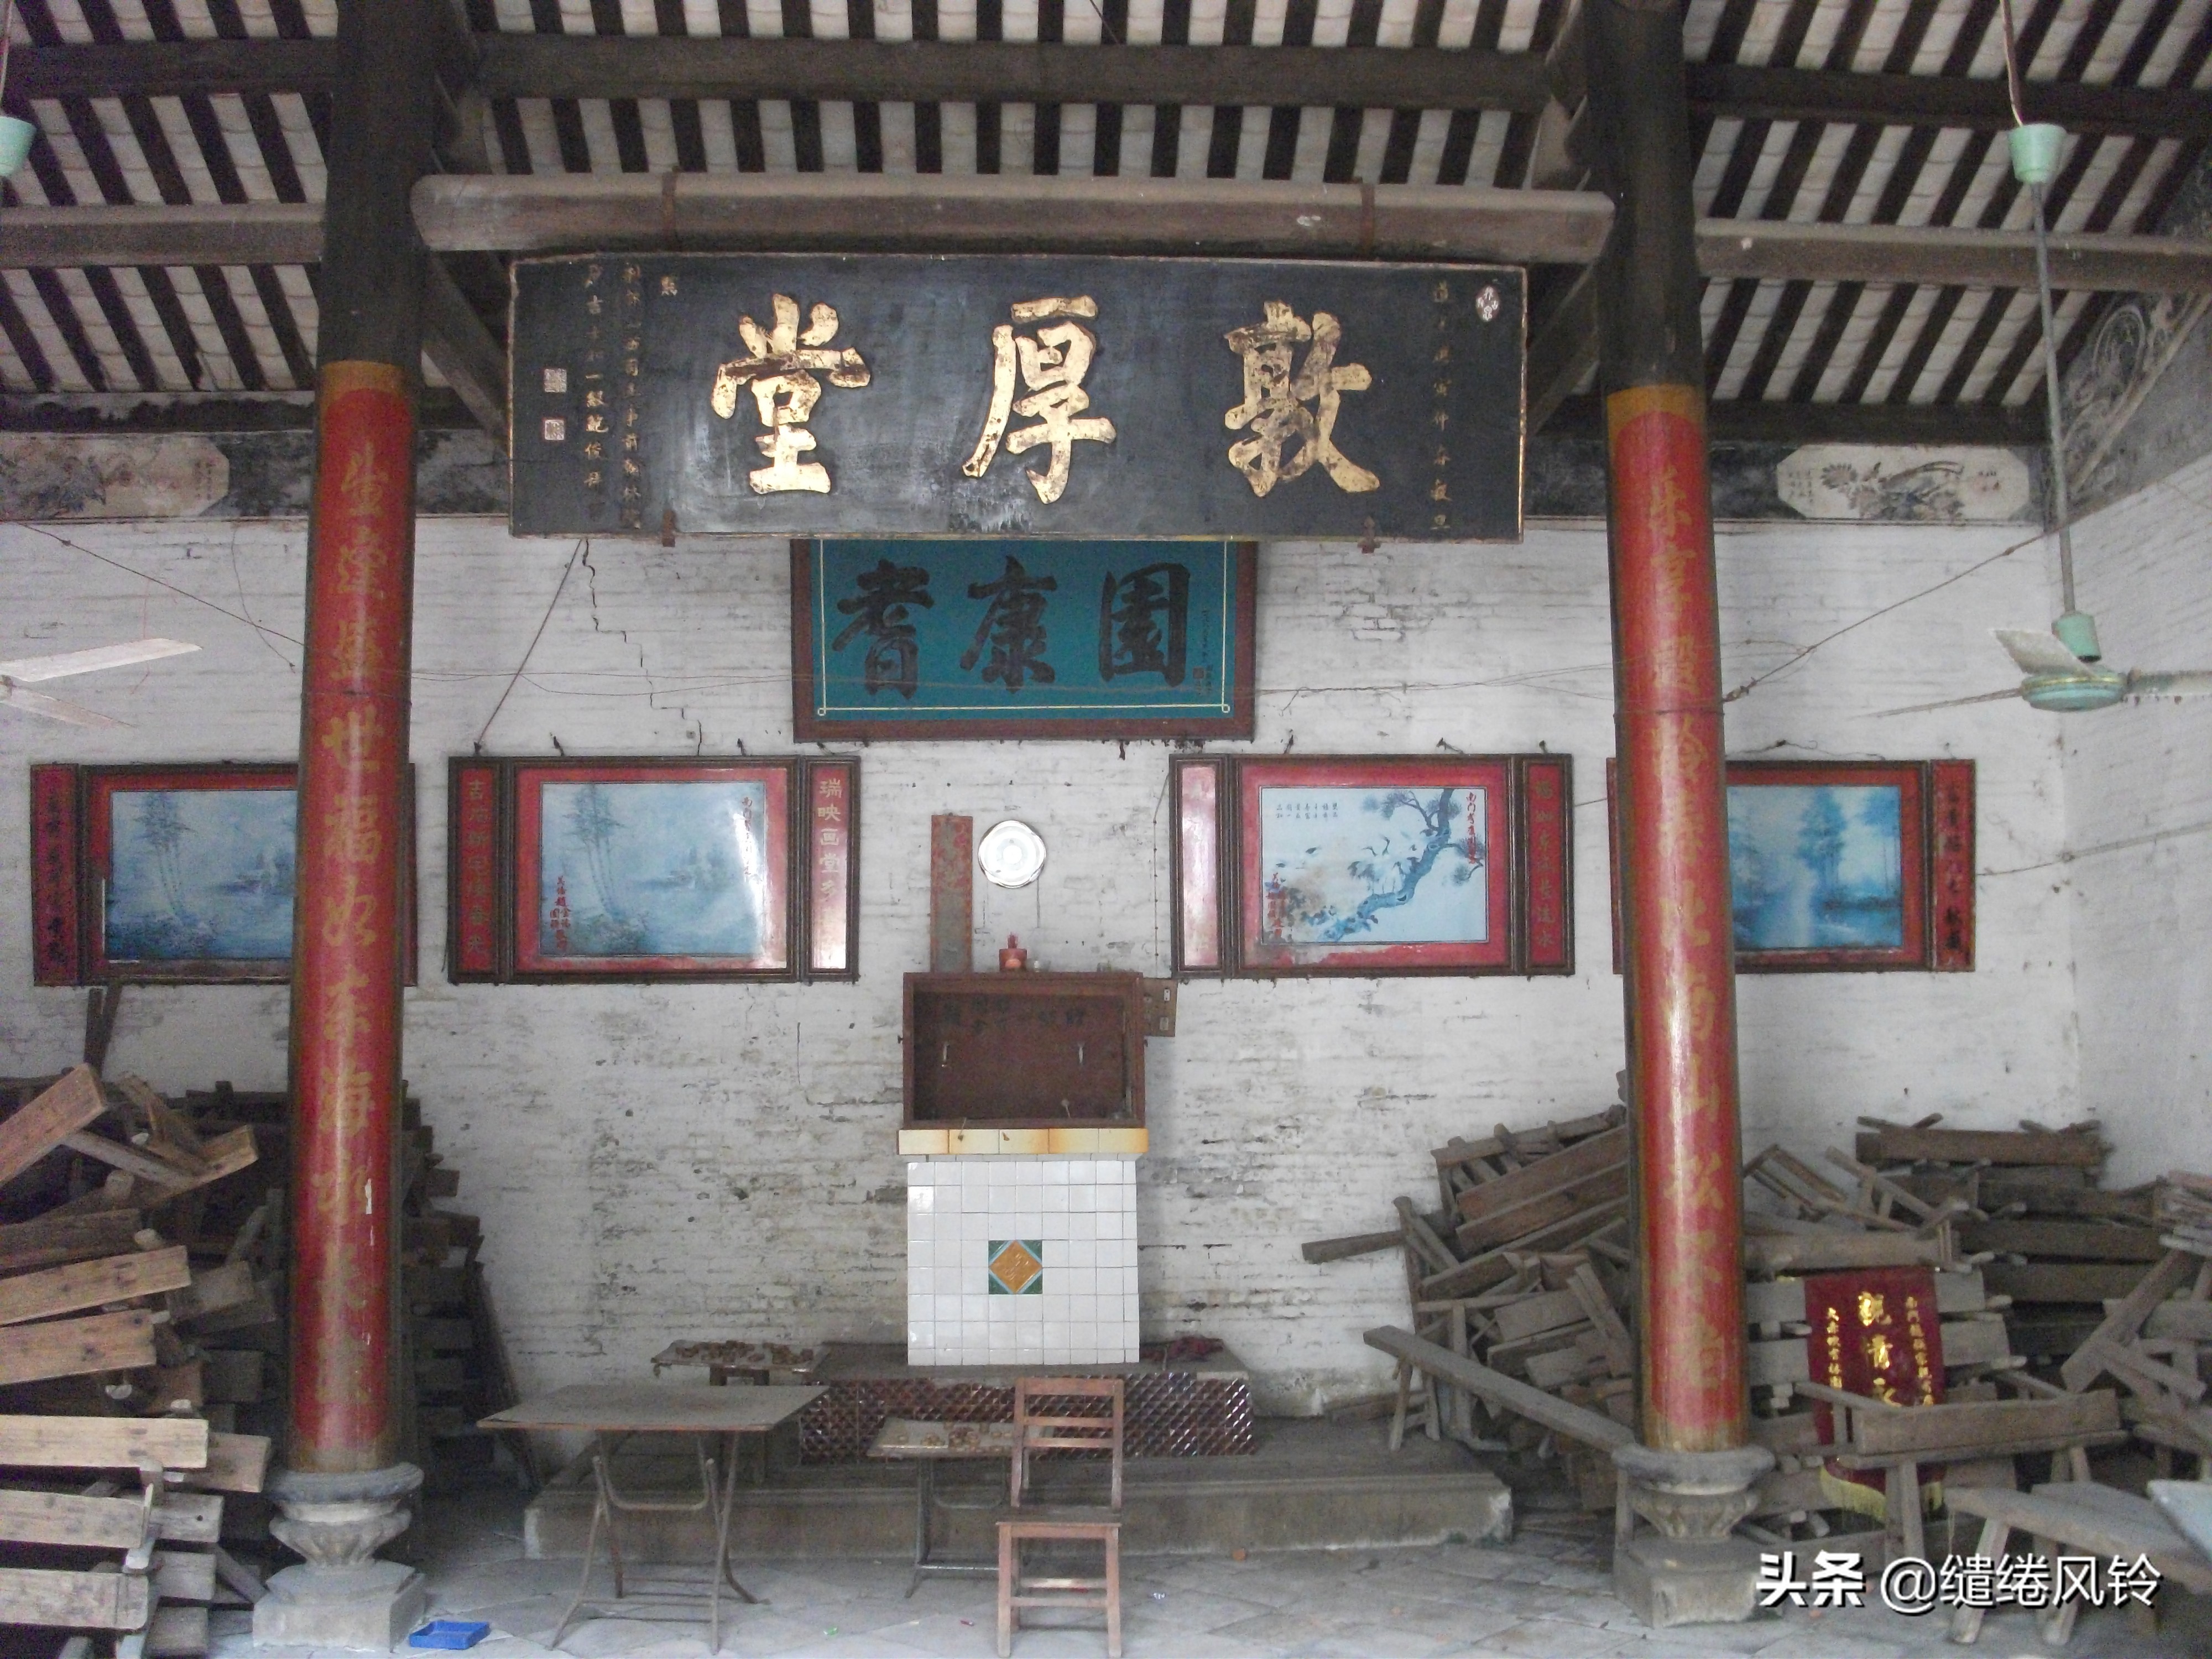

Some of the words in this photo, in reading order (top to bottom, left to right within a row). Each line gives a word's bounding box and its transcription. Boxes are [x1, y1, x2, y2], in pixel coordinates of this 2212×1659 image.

[817, 779, 843, 952] 瑞映画堂多
